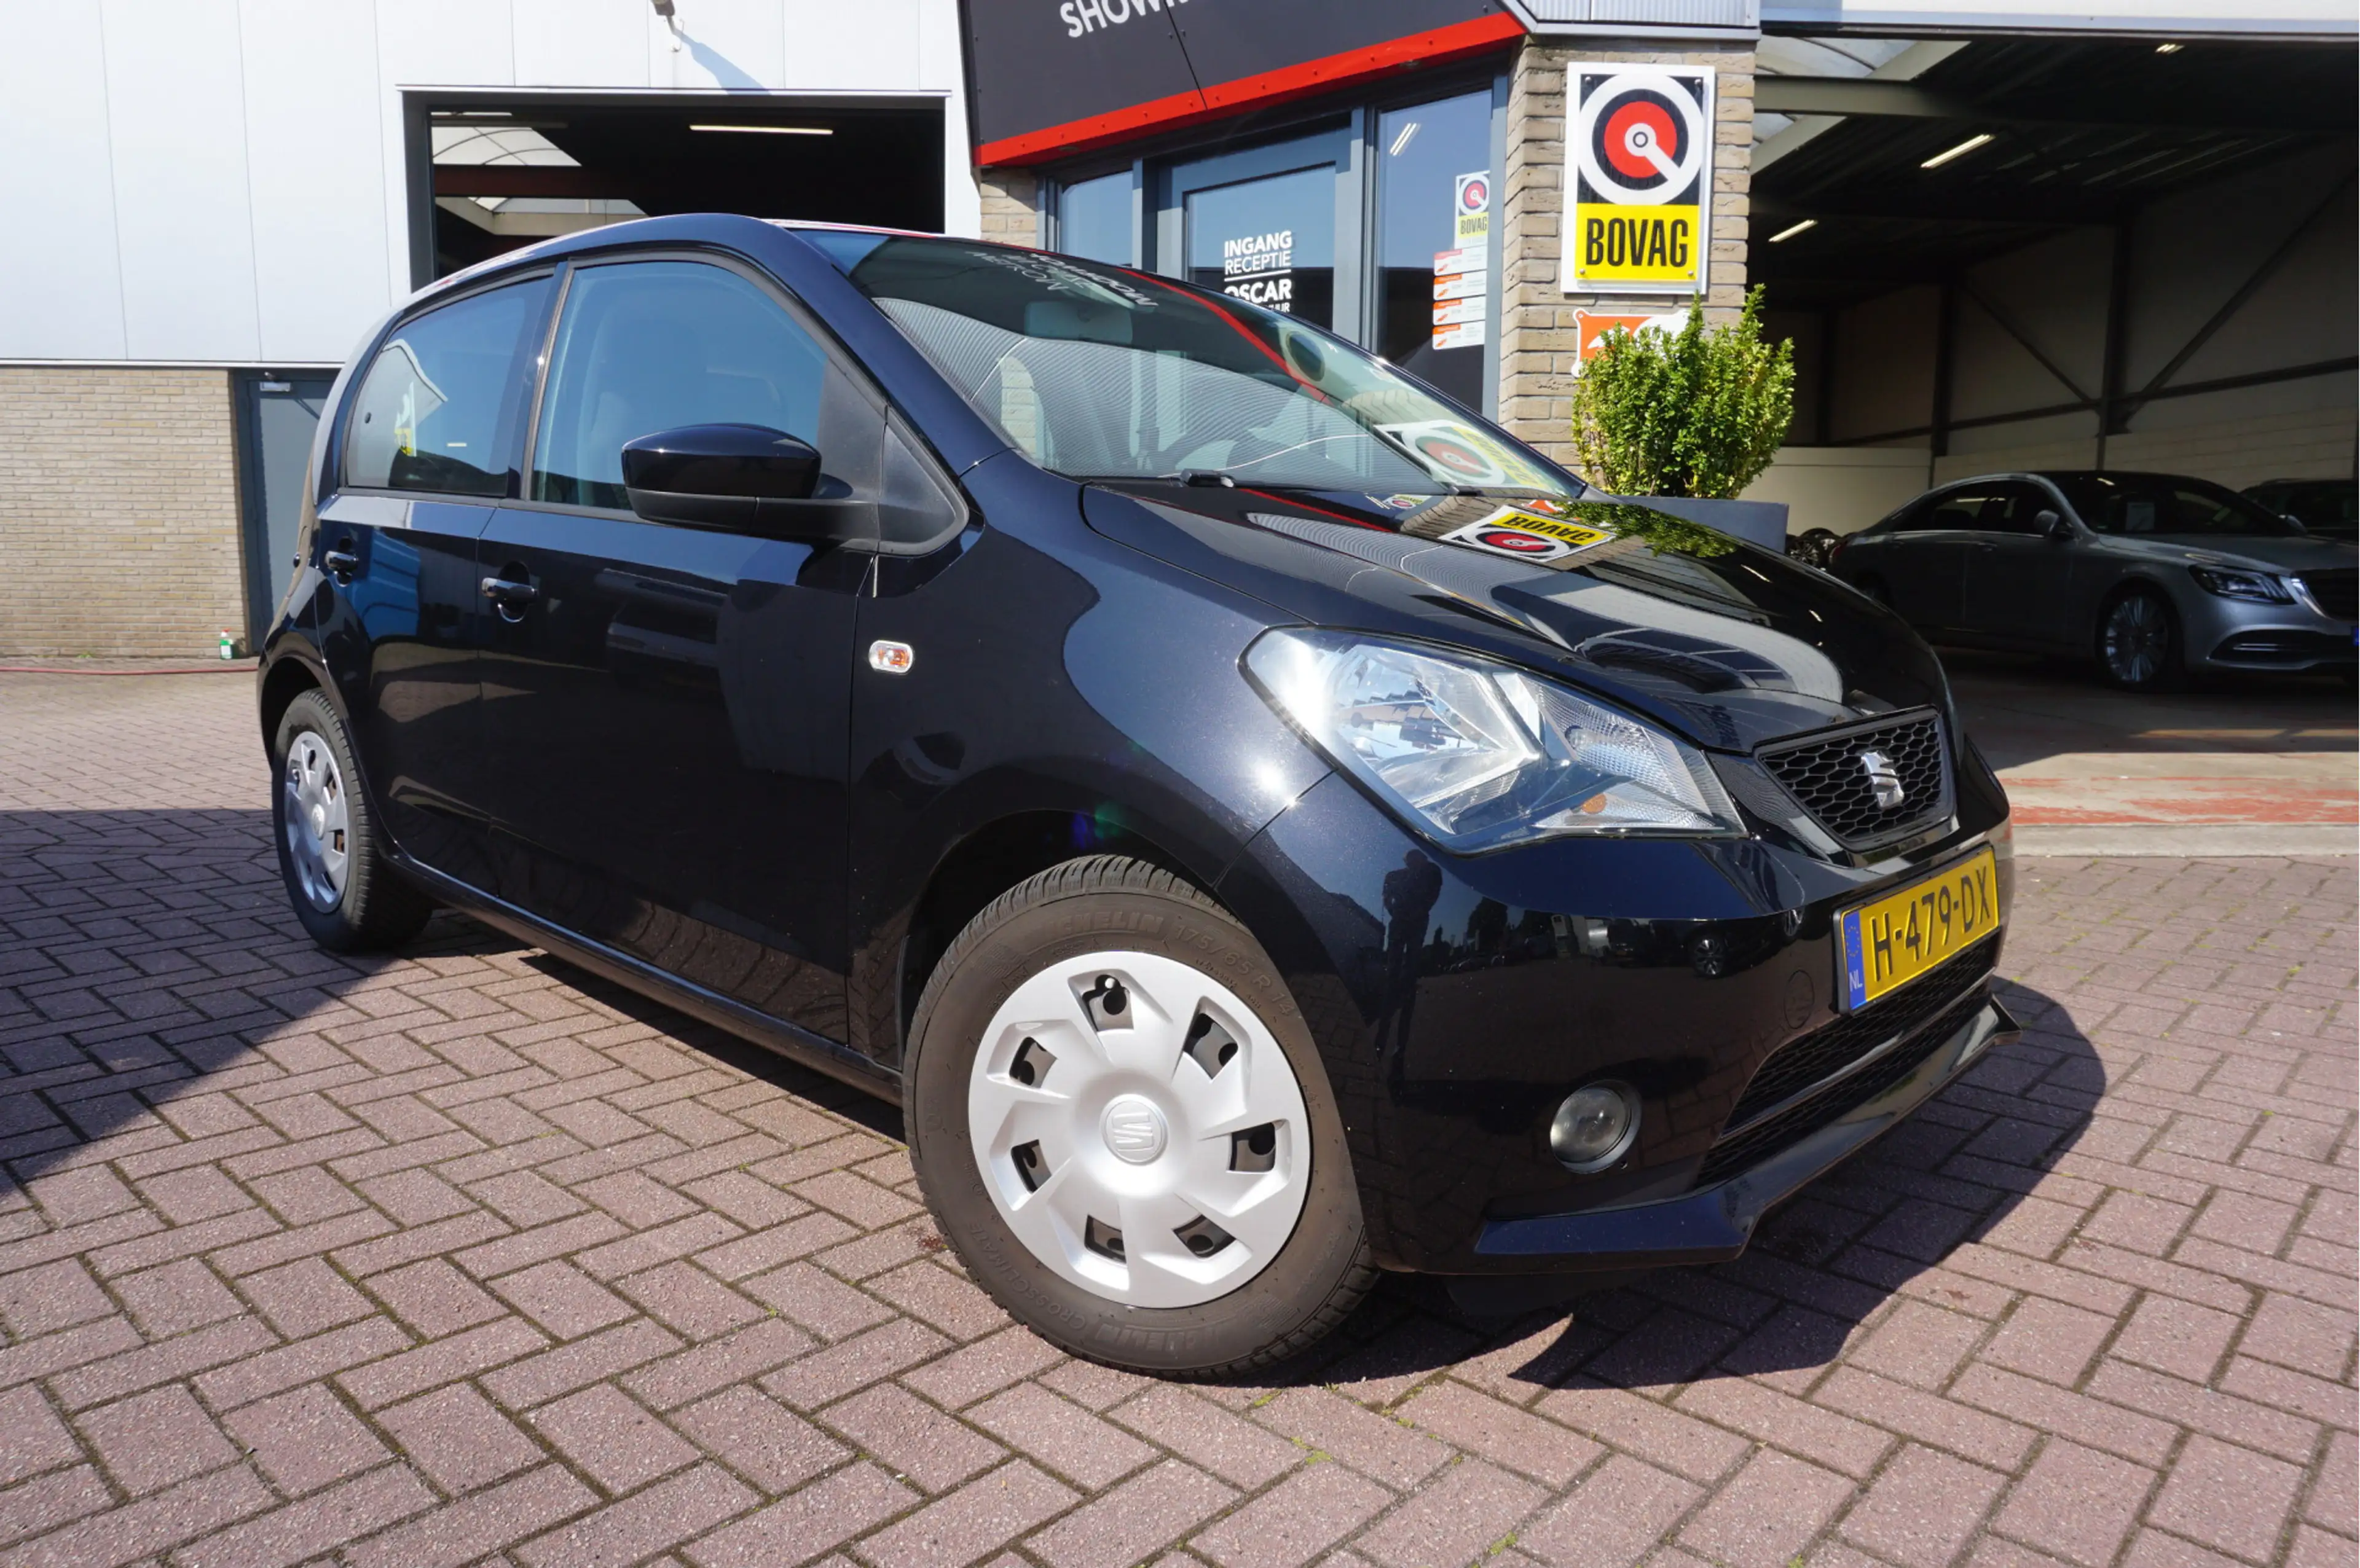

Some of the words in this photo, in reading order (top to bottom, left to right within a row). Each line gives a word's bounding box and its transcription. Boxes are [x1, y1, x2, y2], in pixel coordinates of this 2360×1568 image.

[1460, 216, 1487, 235] BOVAG
[1224, 230, 1292, 258] INGANG
[1586, 218, 1689, 267] BOVAG
[1224, 249, 1292, 275] RECEPTIE
[1870, 865, 1990, 982] H-479-DX
[1253, 974, 1271, 989] R
[1849, 969, 1863, 992] NL
